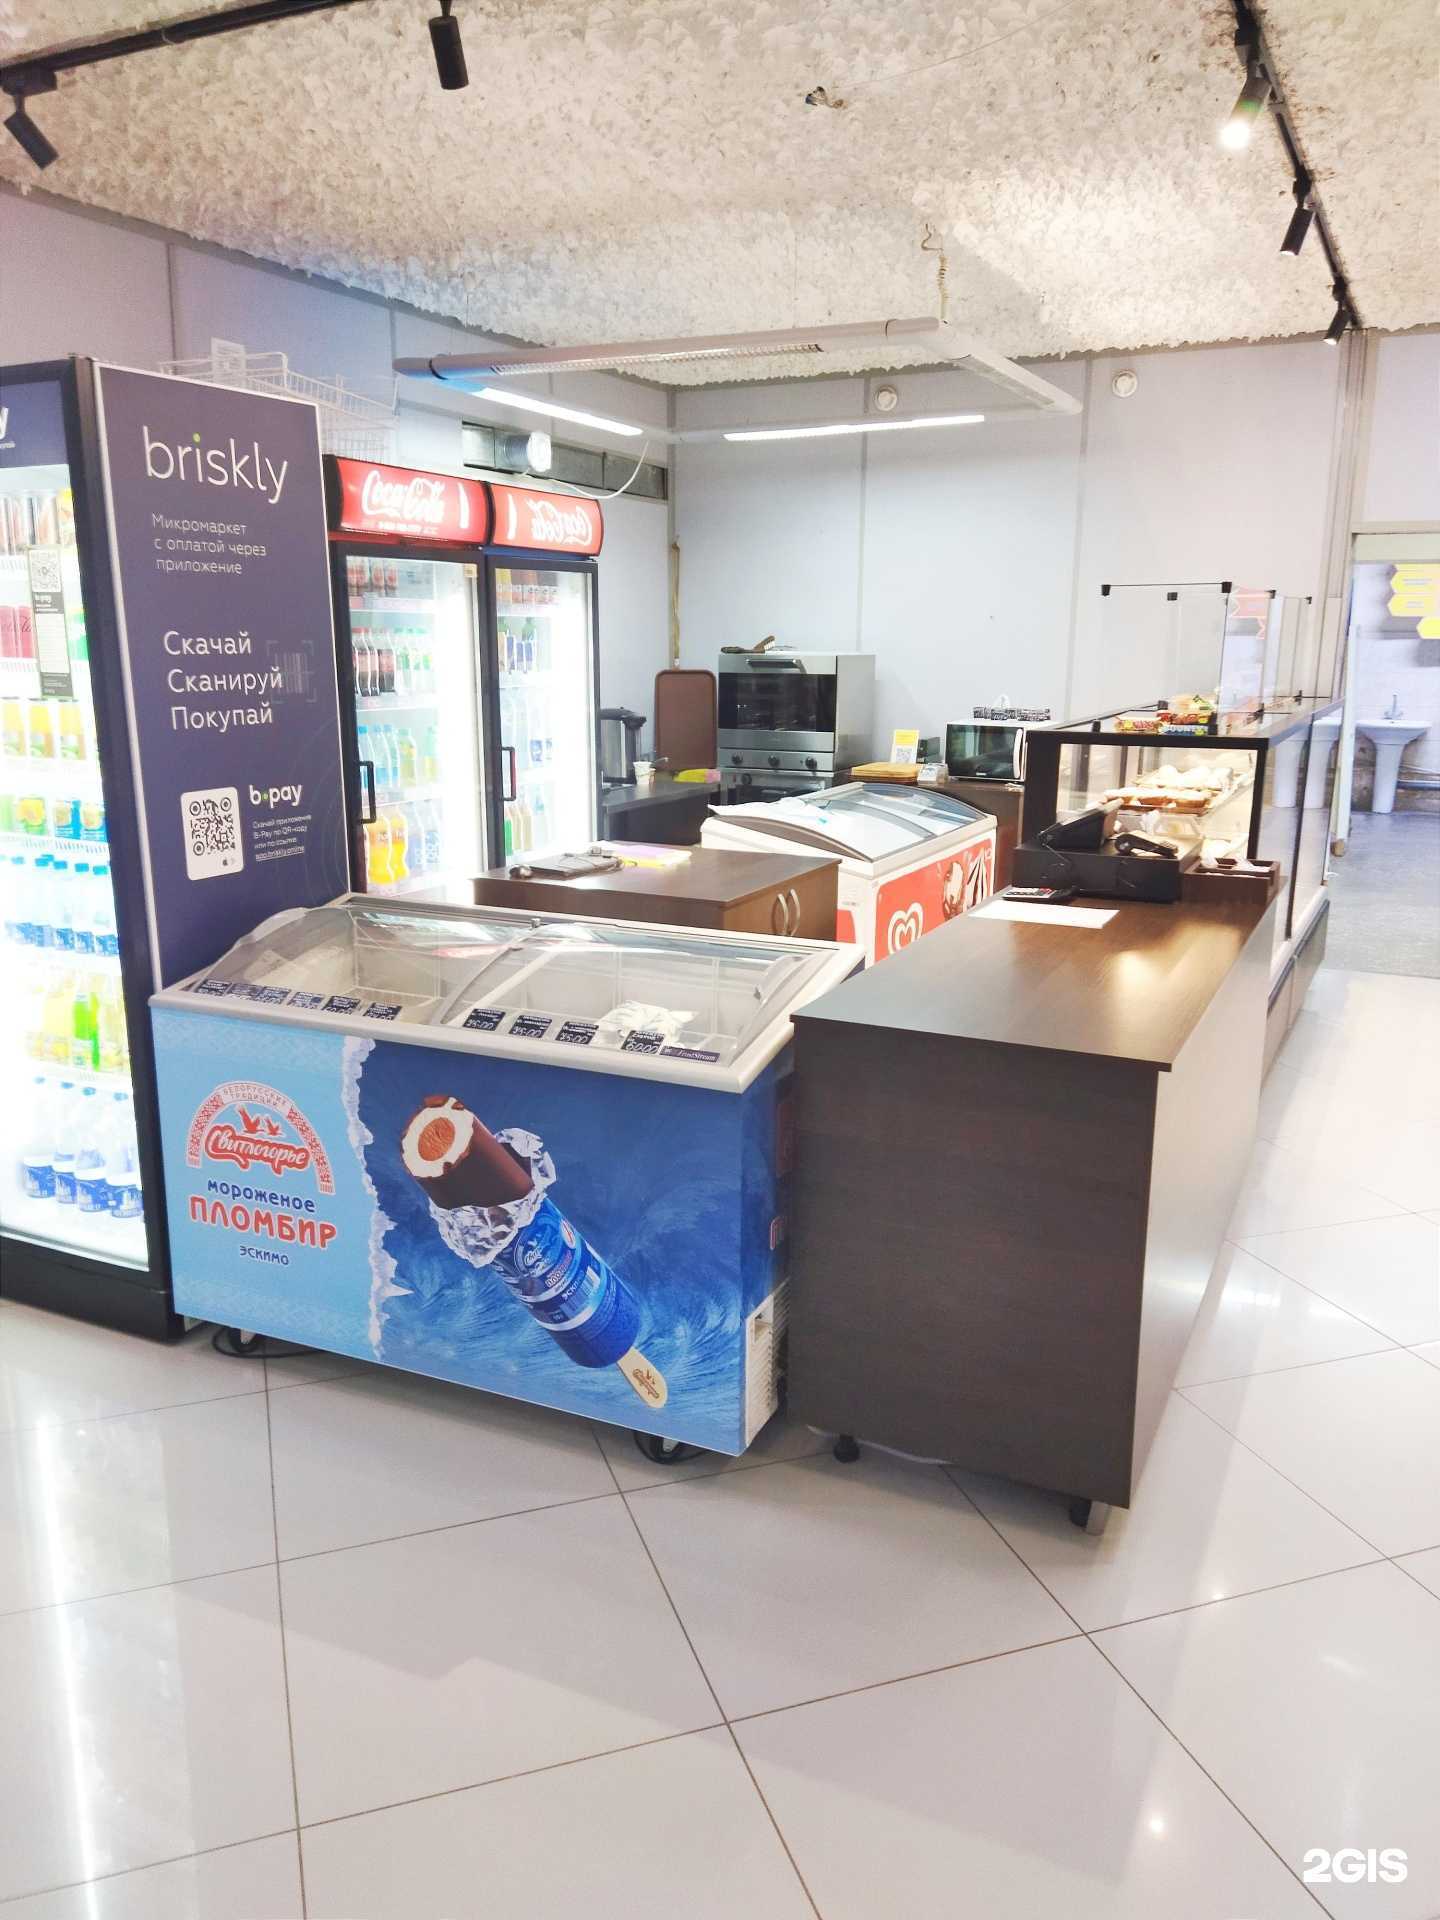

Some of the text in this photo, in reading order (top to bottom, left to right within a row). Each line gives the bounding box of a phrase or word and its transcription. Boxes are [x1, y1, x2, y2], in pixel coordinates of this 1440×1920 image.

[143, 425, 288, 504] briskly
[152, 513, 247, 536] Микромаркет
[154, 538, 267, 558] с оплатой через
[156, 559, 242, 575] приложение
[164, 630, 252, 655] Скачай
[168, 666, 283, 696] Сканируй
[171, 701, 273, 733] Покупай
[208, 1180, 316, 1213] мороженое
[190, 1196, 337, 1249] ПЛОМБИР
